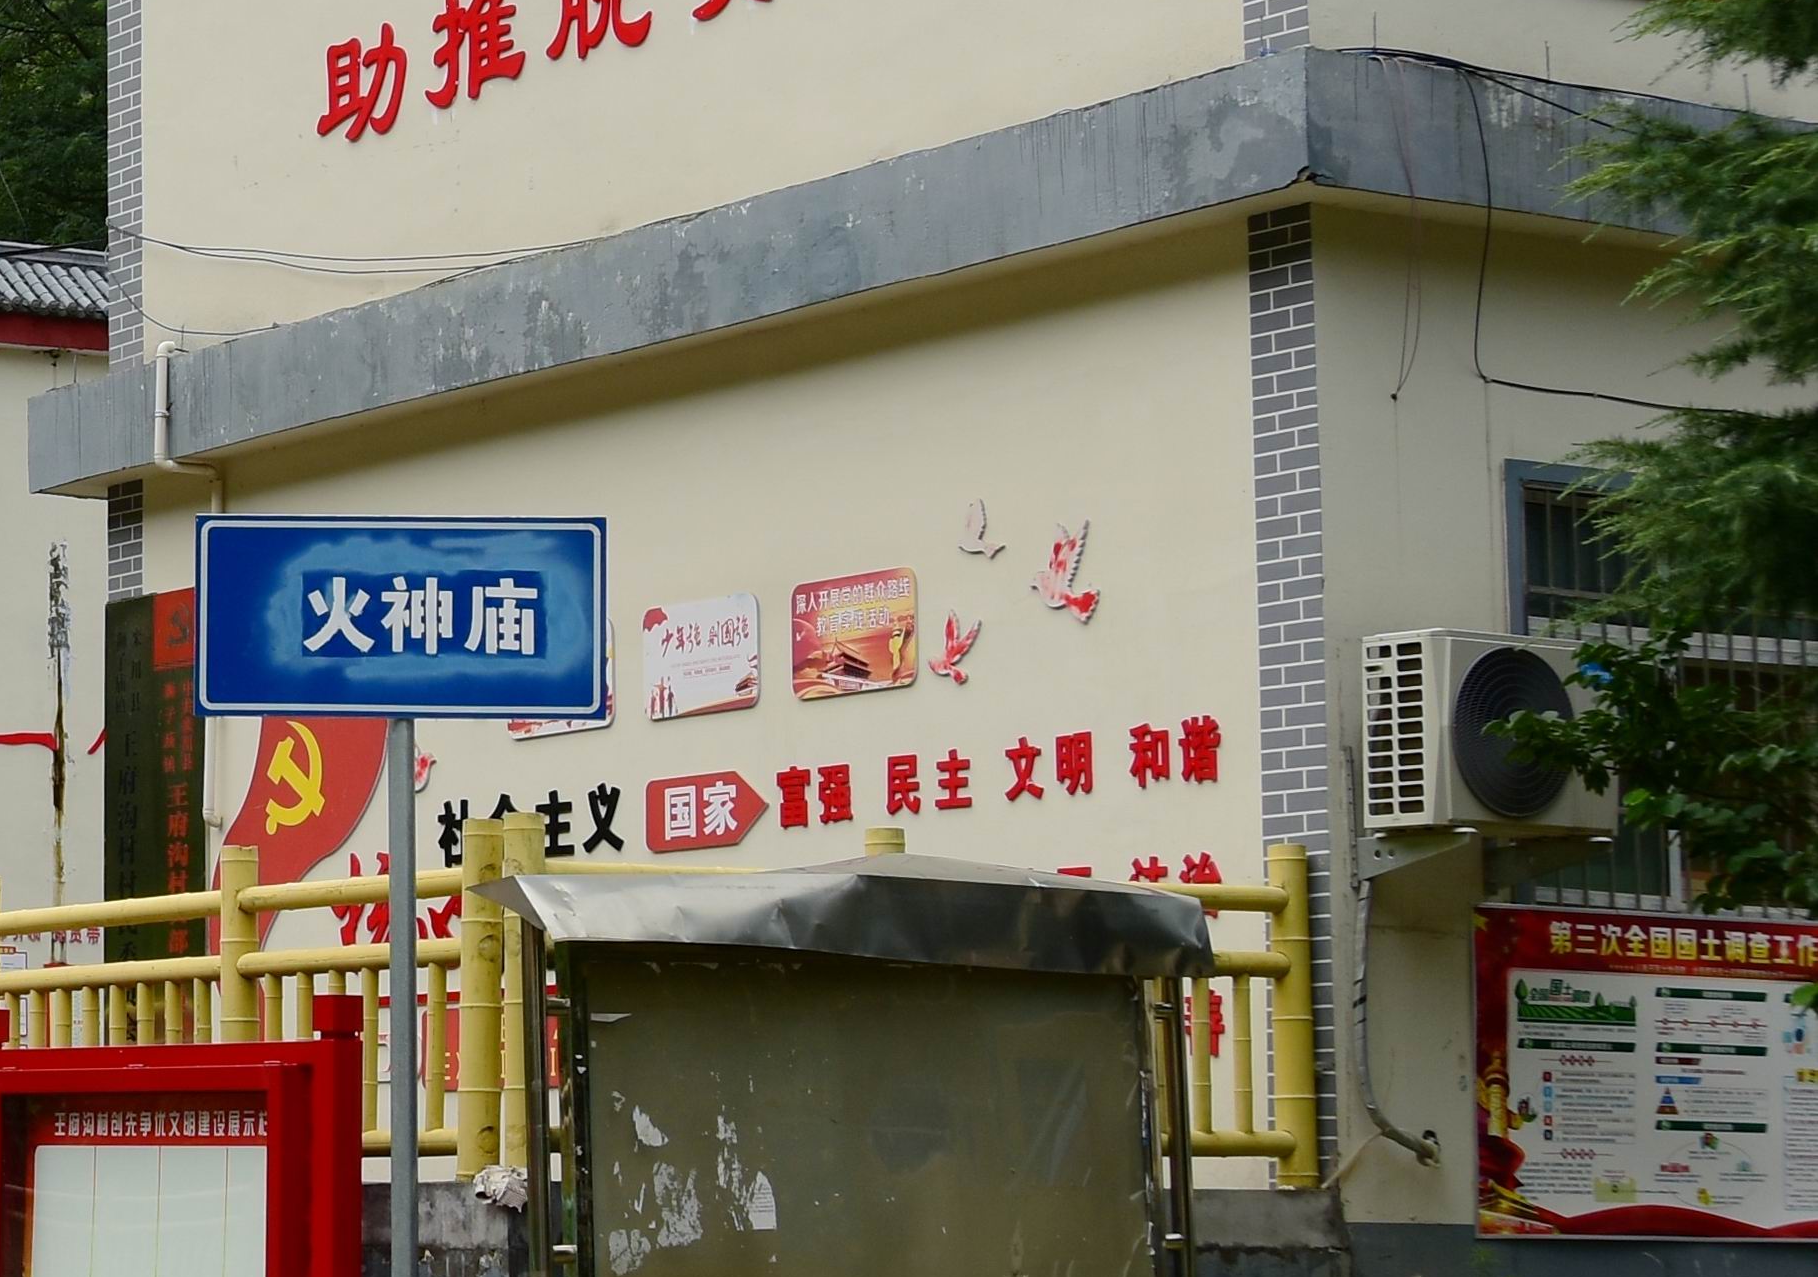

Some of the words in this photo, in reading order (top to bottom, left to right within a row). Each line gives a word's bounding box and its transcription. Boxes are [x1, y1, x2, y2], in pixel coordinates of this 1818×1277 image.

[303, 576, 538, 655] 火神庙
[664, 780, 737, 841] 国家
[776, 765, 853, 829] 富强
[885, 748, 972, 815] 民主
[1005, 736, 1094, 802] 文明
[1129, 715, 1222, 788] 和谐
